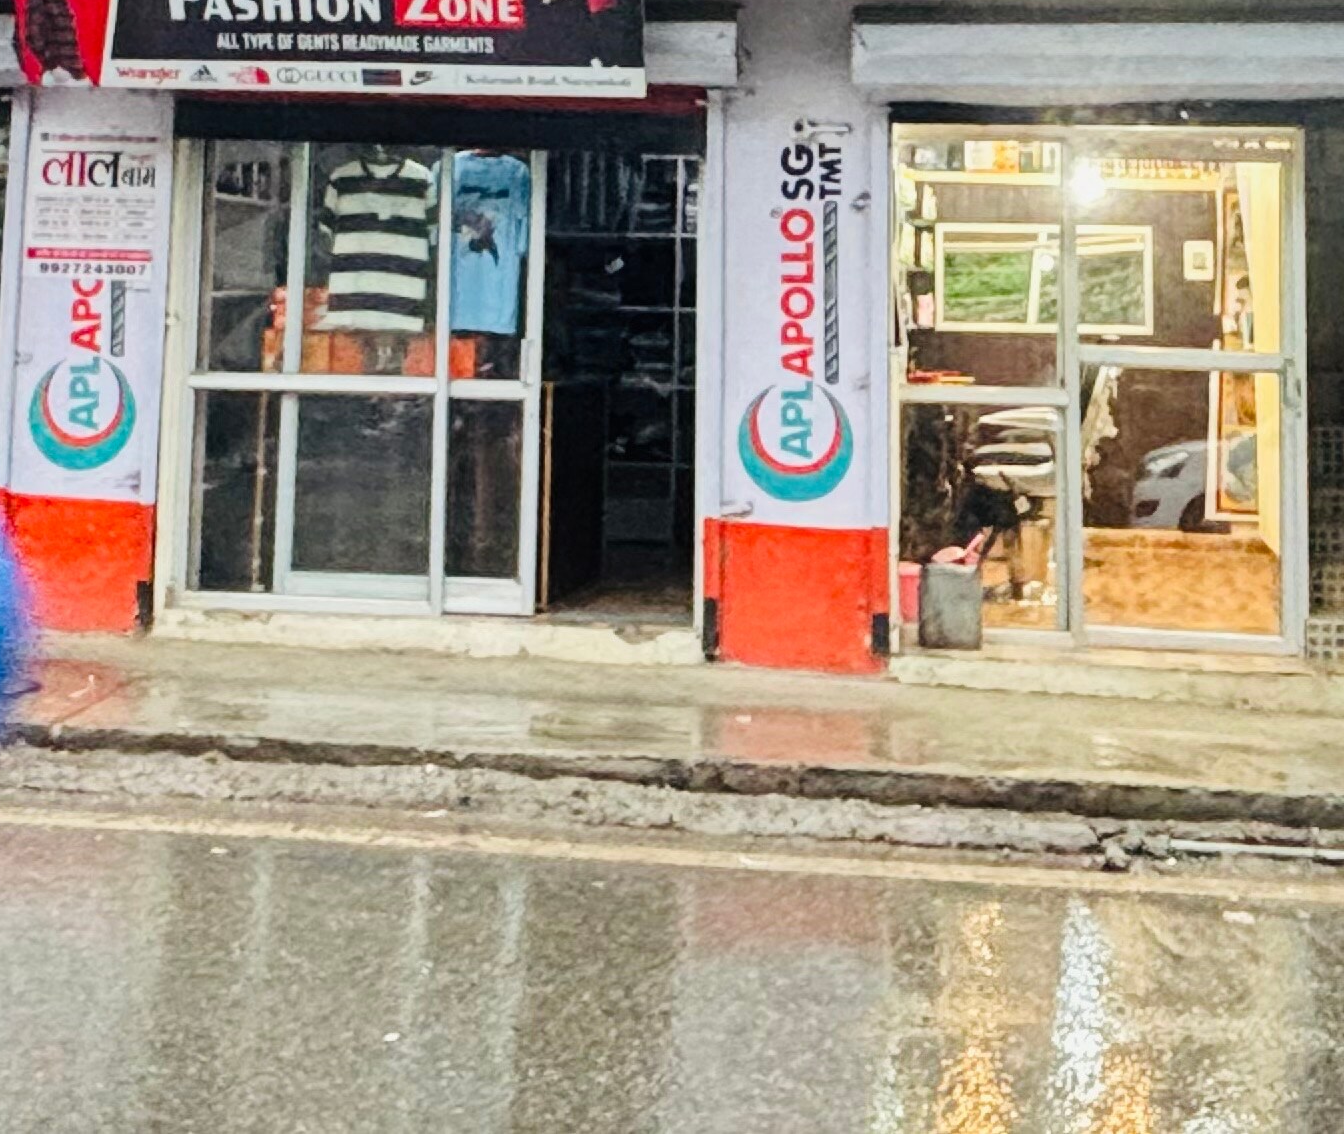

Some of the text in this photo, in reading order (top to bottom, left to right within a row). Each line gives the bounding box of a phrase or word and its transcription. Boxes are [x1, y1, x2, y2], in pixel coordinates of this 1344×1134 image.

[217, 33, 494, 54] ALL TYPE OF GENTS READYMADE GARMENTS
[305, 70, 358, 84] GUCCI
[41, 149, 124, 187] लाल
[780, 143, 815, 202] SG
[819, 143, 842, 201] TMT
[780, 208, 816, 379] APOLLO
[69, 356, 102, 431] APL
[780, 380, 814, 460] APL
